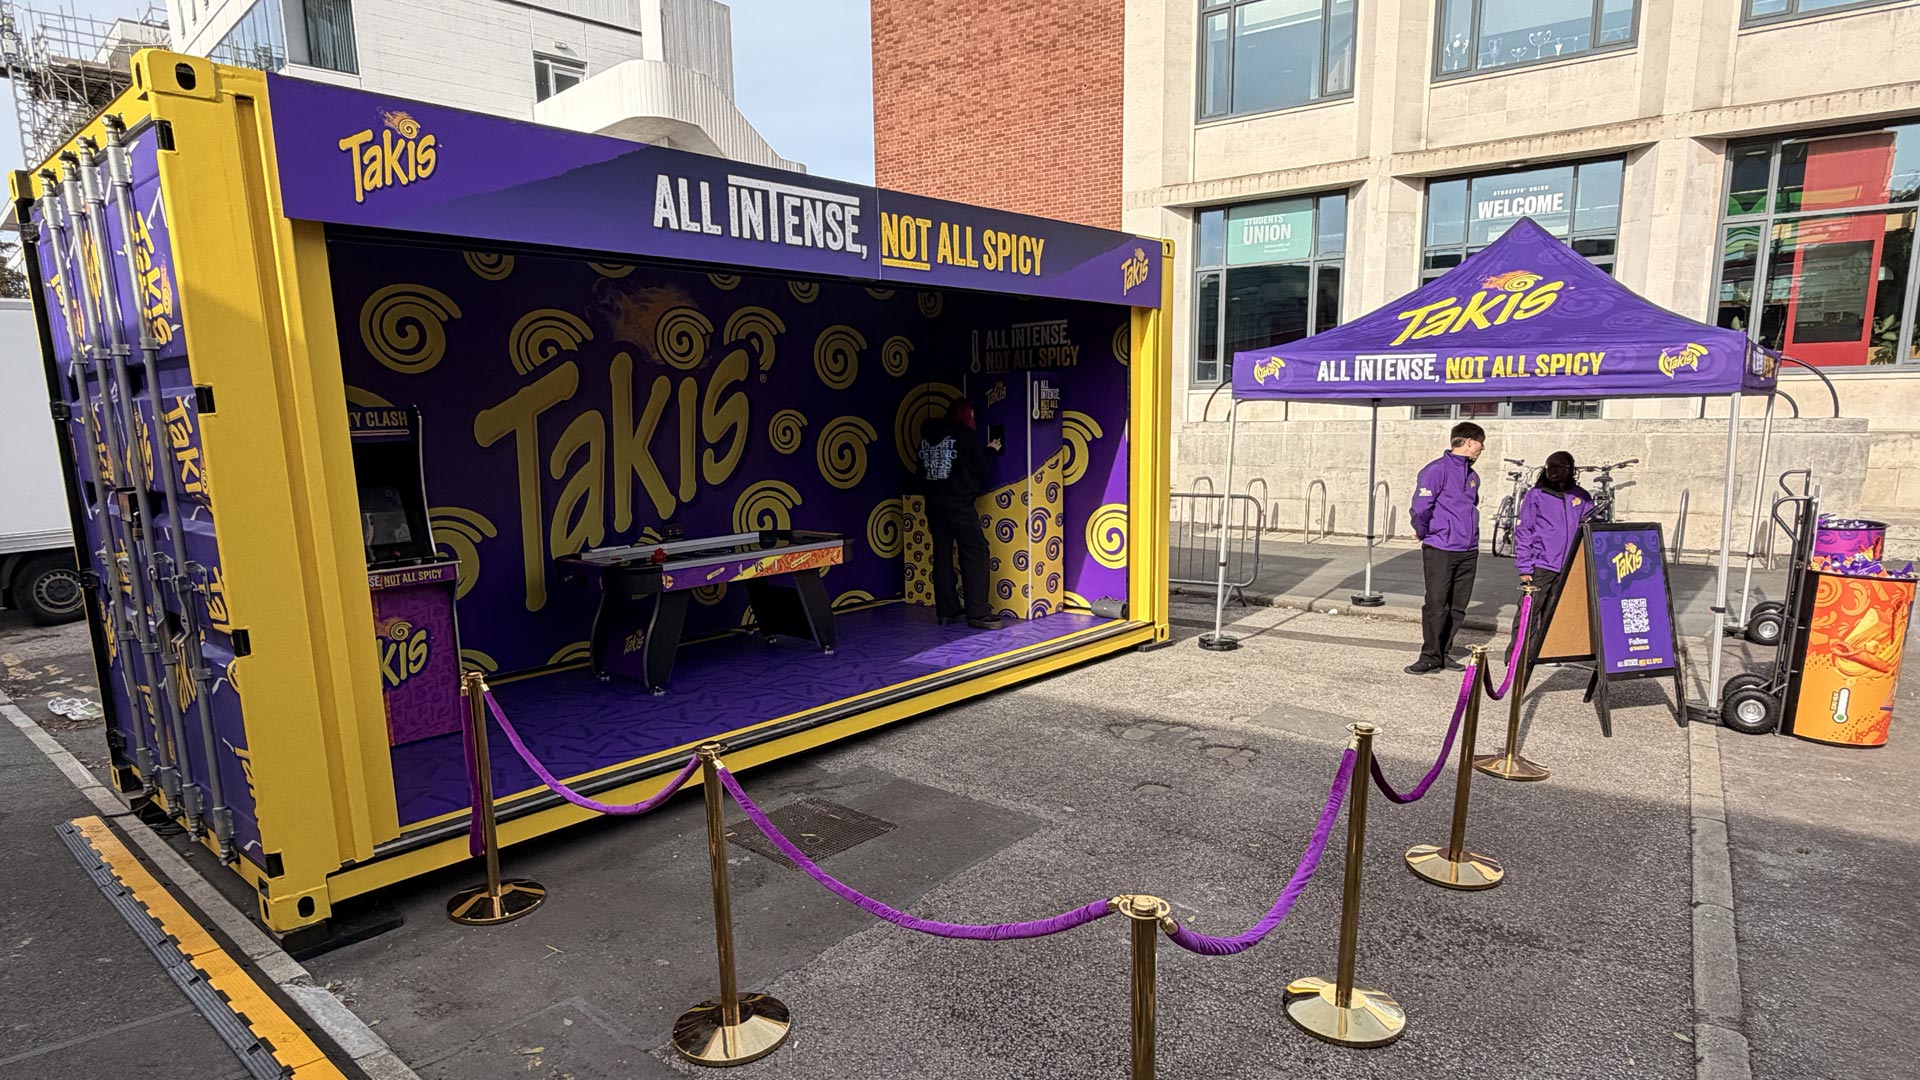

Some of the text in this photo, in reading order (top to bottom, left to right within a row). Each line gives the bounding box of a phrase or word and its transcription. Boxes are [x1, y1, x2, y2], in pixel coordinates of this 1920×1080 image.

[338, 118, 436, 203] Takis
[1478, 192, 1564, 219] WELCOME
[653, 174, 1045, 276] ALL INTENSE, NOT ALL SPICY
[1243, 223, 1291, 246] UNION
[1120, 252, 1149, 297] Takis
[1389, 275, 1565, 347] Takis
[986, 319, 1071, 350] ALL INTENSE,
[985, 345, 1080, 374] NOT ALL SPICY
[1317, 351, 1606, 384] ALL INTENSE, NOT ALL SPICY
[365, 411, 408, 427] CLASH
[474, 306, 750, 612] Takis
[384, 574, 401, 588] NOT
[402, 572, 418, 584] ALL
[418, 569, 443, 581] SPICY
[754, 561, 764, 573] VS
[1612, 545, 1643, 584] Takis
[1628, 637, 1649, 646] Follow
